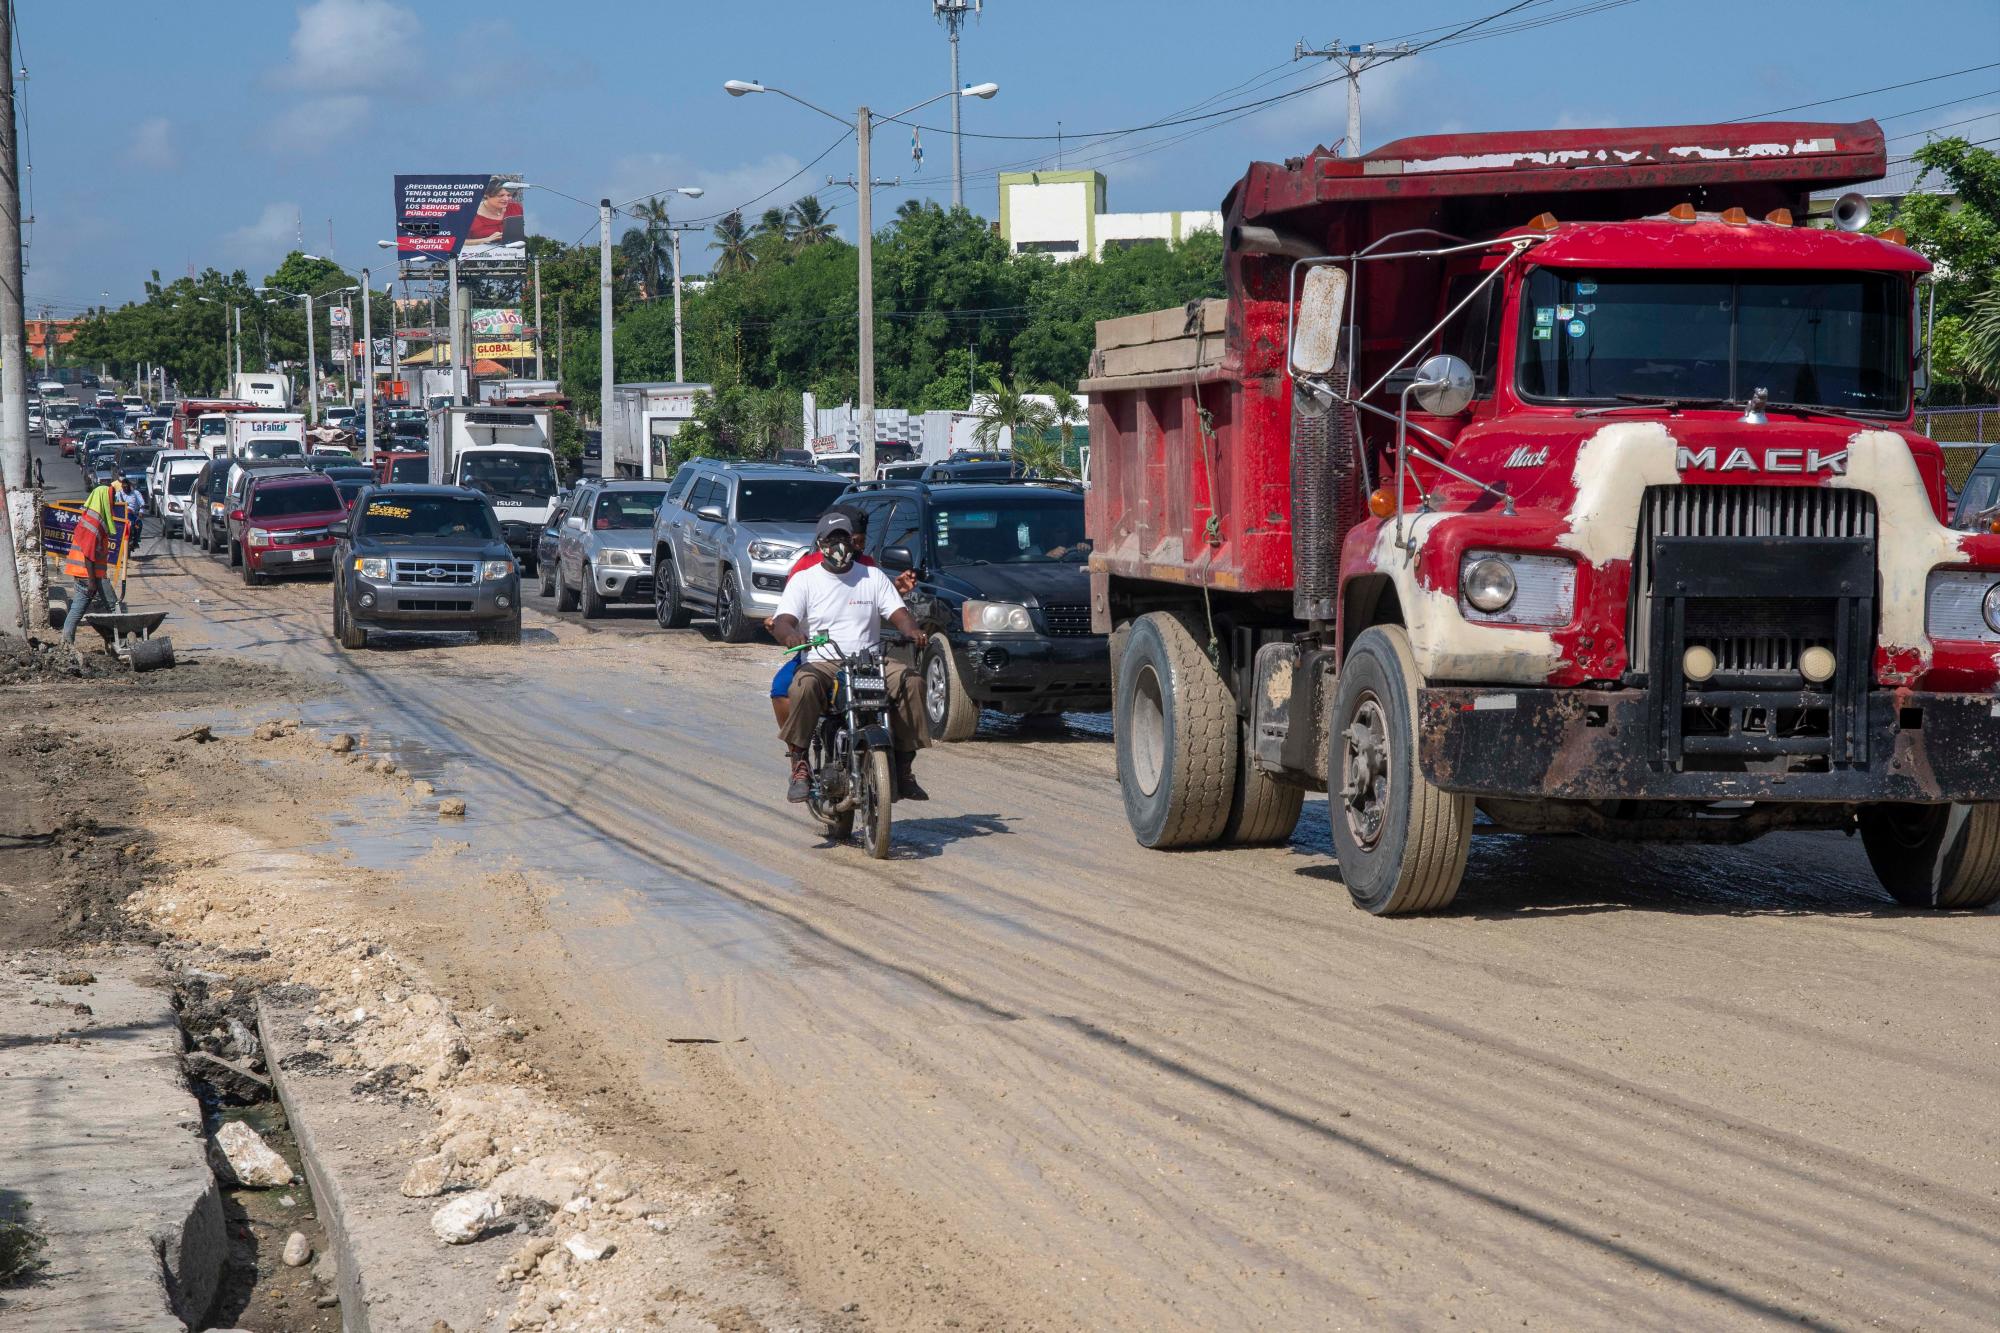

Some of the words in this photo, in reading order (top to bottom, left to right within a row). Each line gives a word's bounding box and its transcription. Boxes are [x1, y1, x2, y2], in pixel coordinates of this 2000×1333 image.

[477, 344, 514, 353] GLOBAL
[1503, 445, 1550, 468] Mack
[1676, 446, 1848, 475] MACK
